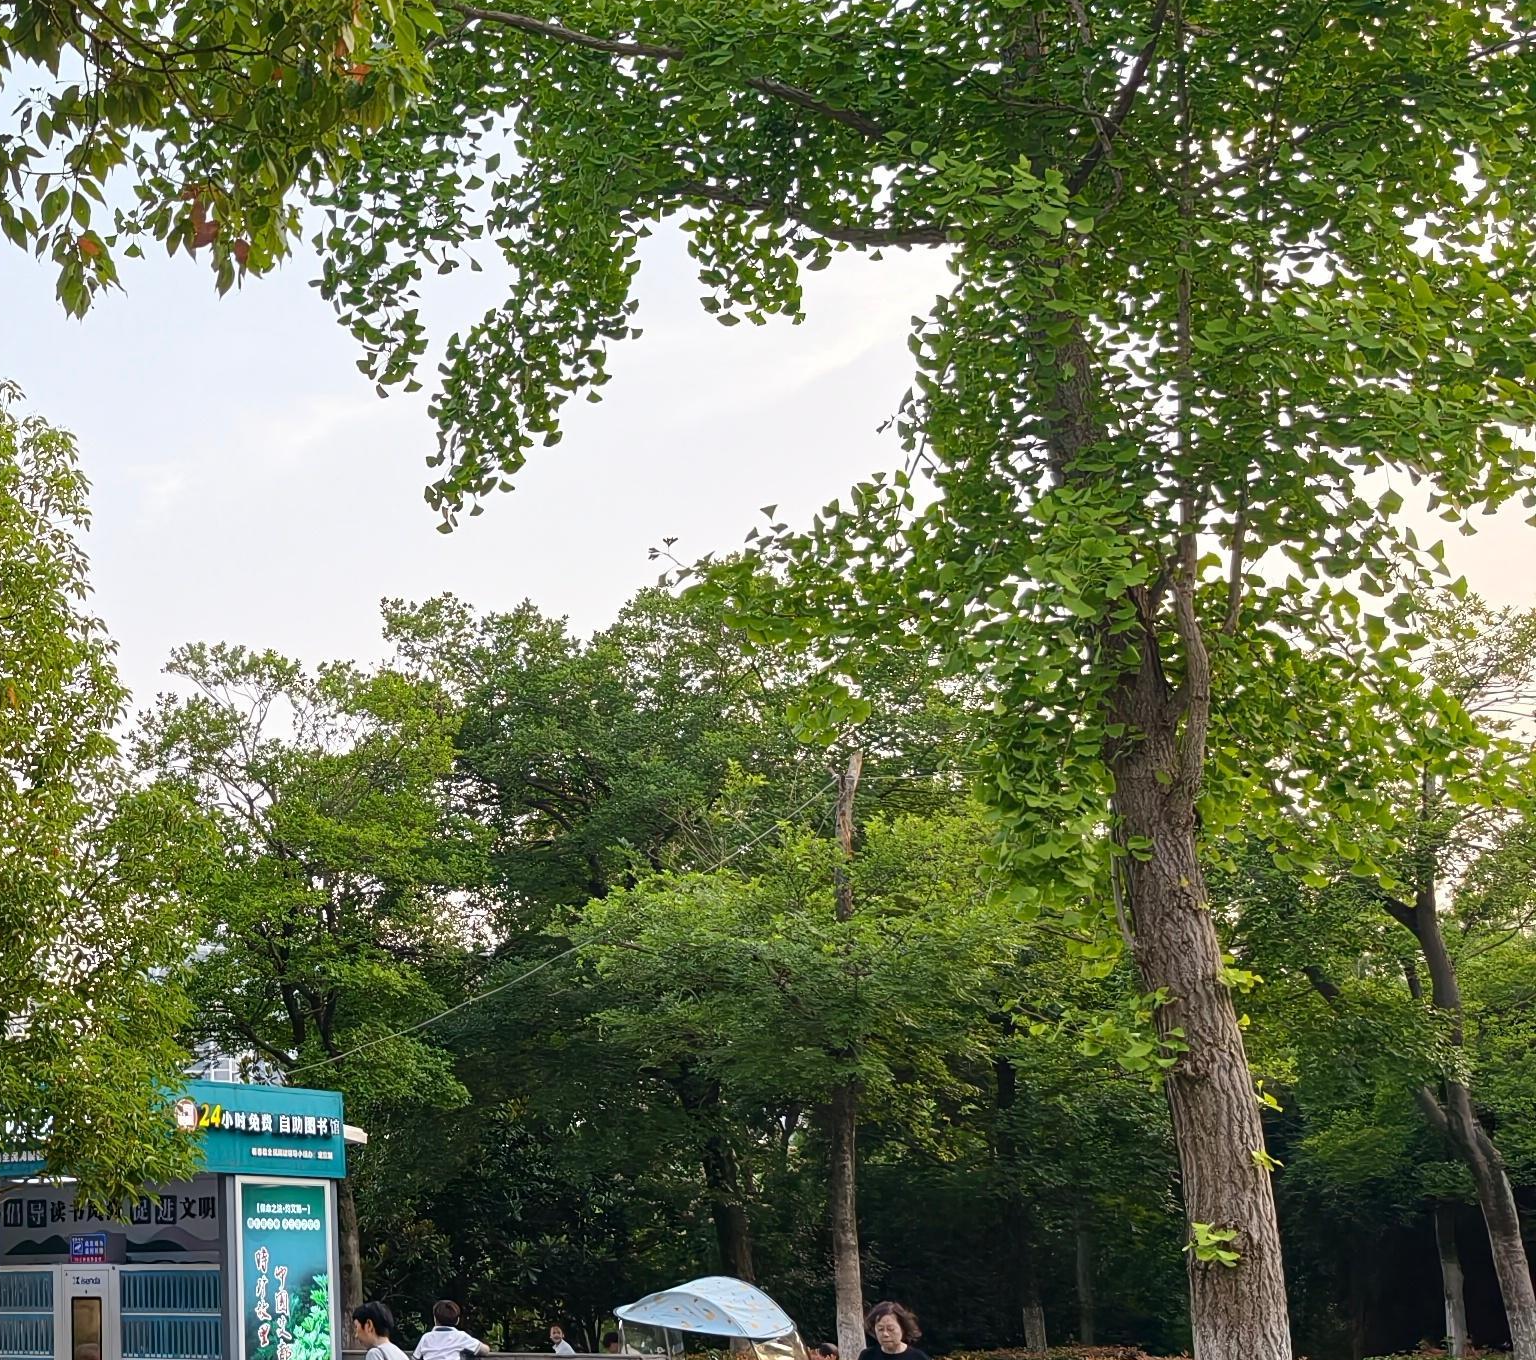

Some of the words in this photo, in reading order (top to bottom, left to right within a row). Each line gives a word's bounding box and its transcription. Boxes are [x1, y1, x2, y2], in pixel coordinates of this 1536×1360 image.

[199, 1104, 273, 1133] 24小时免费
[279, 1115, 340, 1136] 自助图书馆
